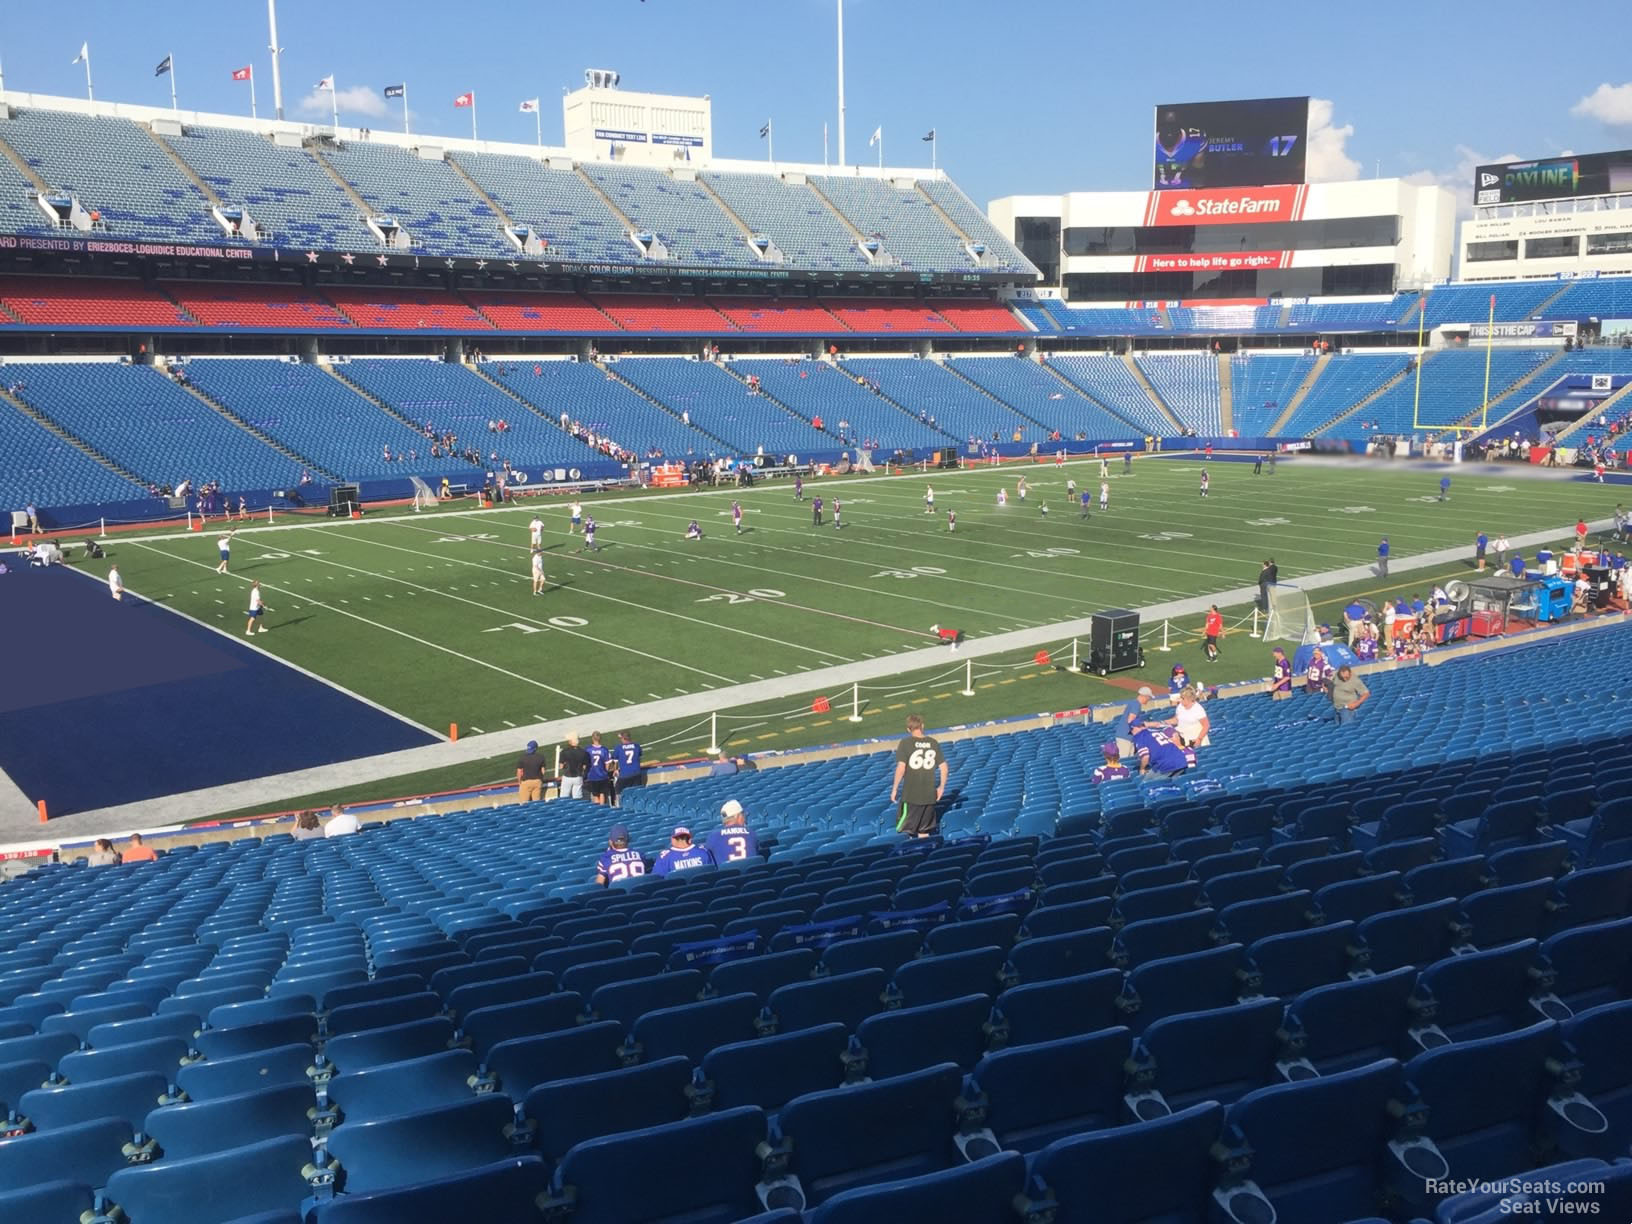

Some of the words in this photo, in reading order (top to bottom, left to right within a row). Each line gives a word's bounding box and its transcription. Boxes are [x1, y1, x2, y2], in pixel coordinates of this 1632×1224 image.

[1208, 143, 1244, 152] BUTLER
[1269, 135, 1298, 157] 17
[20, 238, 70, 250] PRESENTED
[73, 240, 85, 250] BY
[176, 246, 225, 258] EDUCATIONAL
[225, 248, 253, 259] CENTER
[1152, 258, 1175, 268] Here
[1177, 257, 1188, 267] to
[1189, 257, 1210, 268] help
[1212, 256, 1228, 266] life
[1230, 257, 1242, 267] go
[589, 264, 611, 274] COLOR
[611, 265, 634, 275] GUARD
[1499, 326, 1516, 336] THE
[1516, 325, 1536, 336] CAP
[709, 588, 787, 604] 20
[500, 615, 589, 635] 10
[1308, 665, 1320, 681] 12
[593, 755, 600, 766] 7
[625, 750, 635, 764] 7
[908, 749, 936, 770] 68
[720, 826, 750, 836] MANUEL
[727, 836, 747, 861] 3
[611, 851, 642, 863] SPILLER
[673, 856, 703, 871] WATKINS
